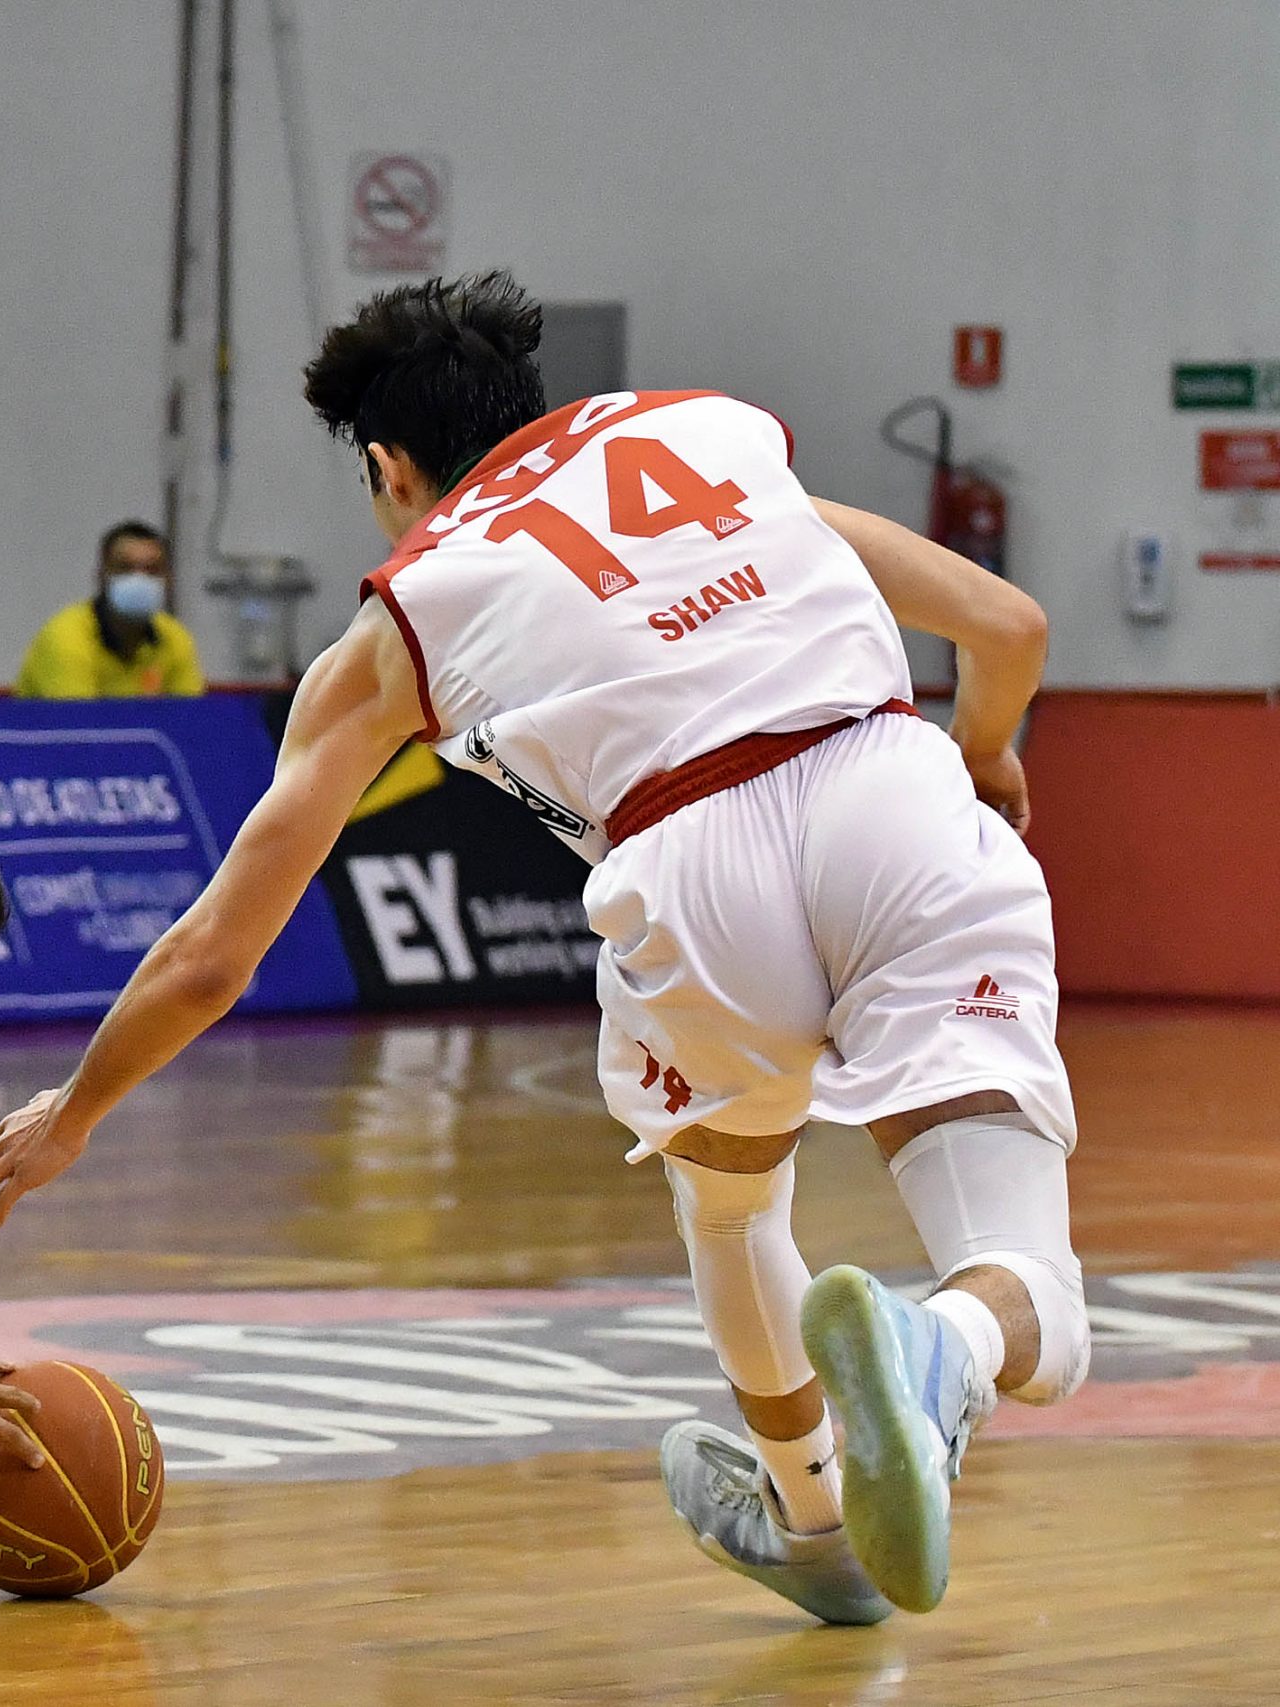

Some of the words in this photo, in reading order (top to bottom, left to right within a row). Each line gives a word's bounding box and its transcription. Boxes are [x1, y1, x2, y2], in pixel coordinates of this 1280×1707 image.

[426, 390, 639, 534] KTO
[483, 436, 754, 602] 14
[647, 563, 767, 642] SHAW
[346, 851, 477, 985] EY
[955, 1005, 1020, 1021] CATERA
